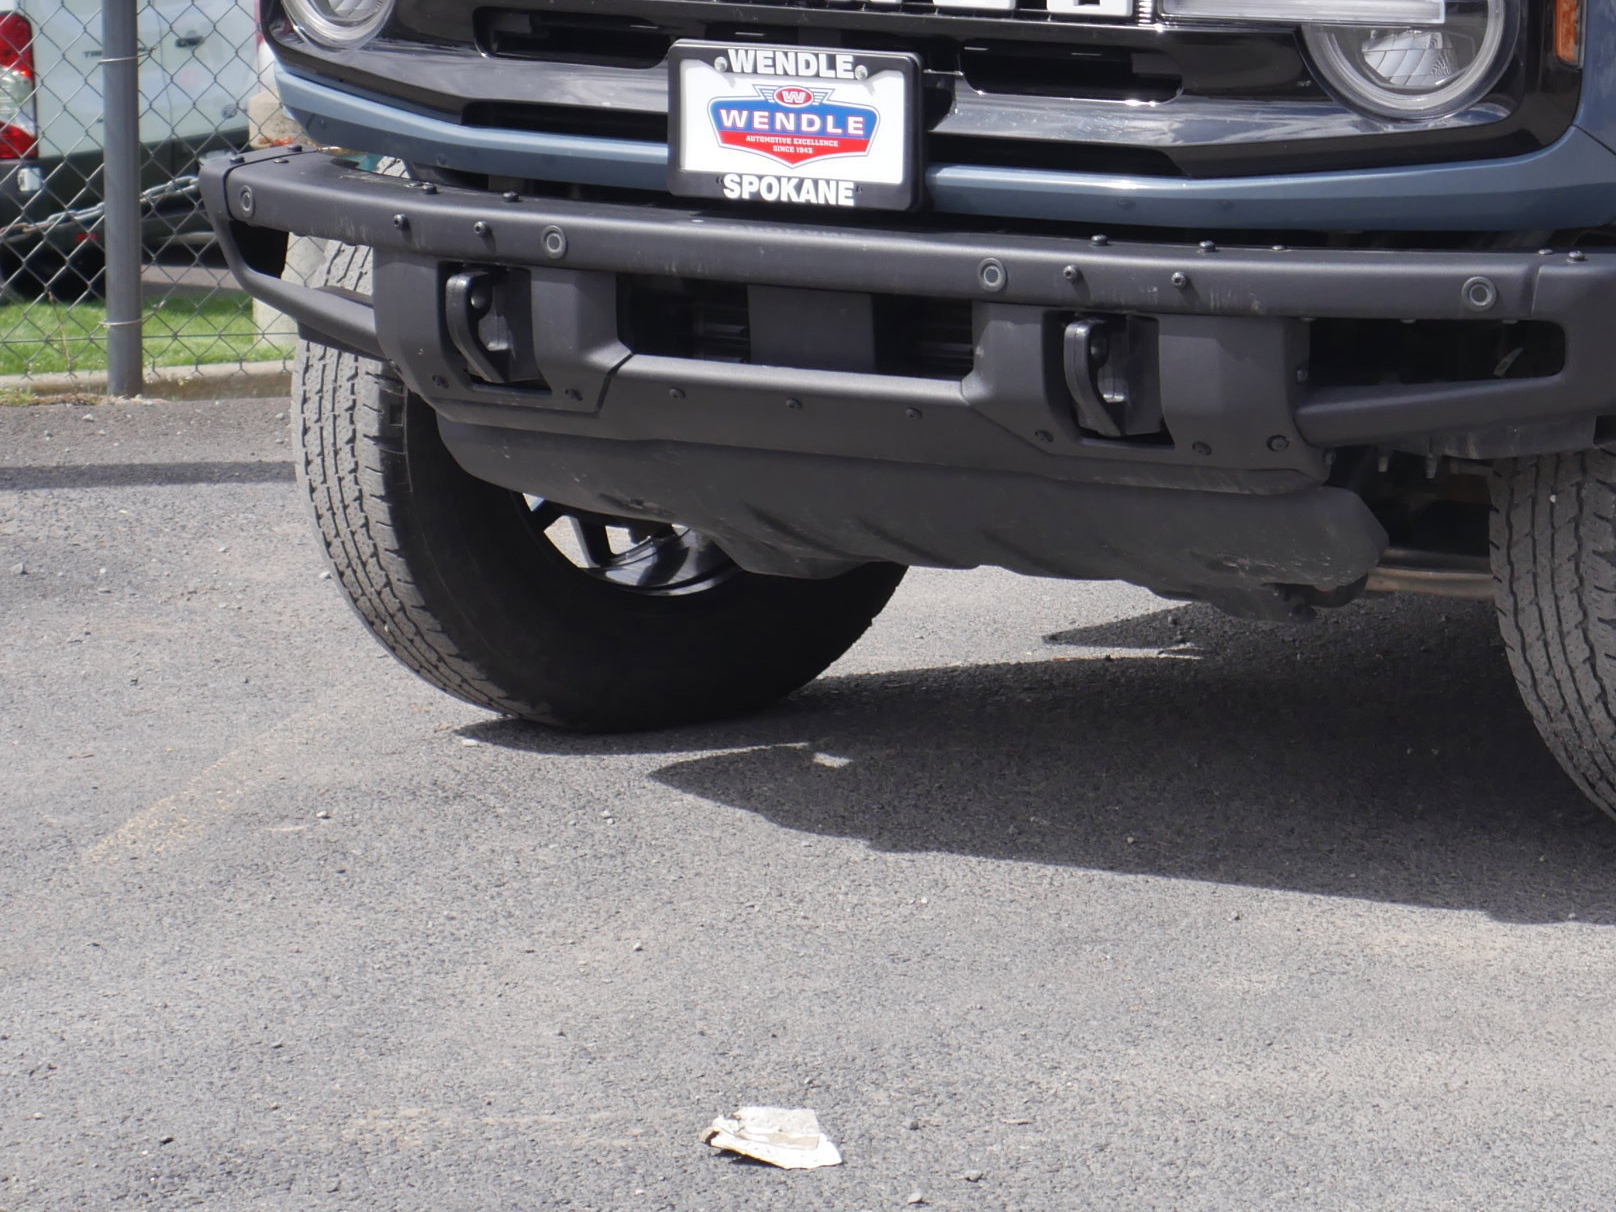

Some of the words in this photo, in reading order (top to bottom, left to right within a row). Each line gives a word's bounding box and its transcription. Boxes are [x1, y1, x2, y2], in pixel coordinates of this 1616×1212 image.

[727, 48, 856, 79] WENDLE
[719, 109, 864, 135] WENDLE
[745, 135, 792, 145] AUTOMOTIVE
[793, 137, 839, 147] EXCELLENCE
[773, 145, 794, 153] SINCE
[723, 173, 855, 206] SPOKANE
